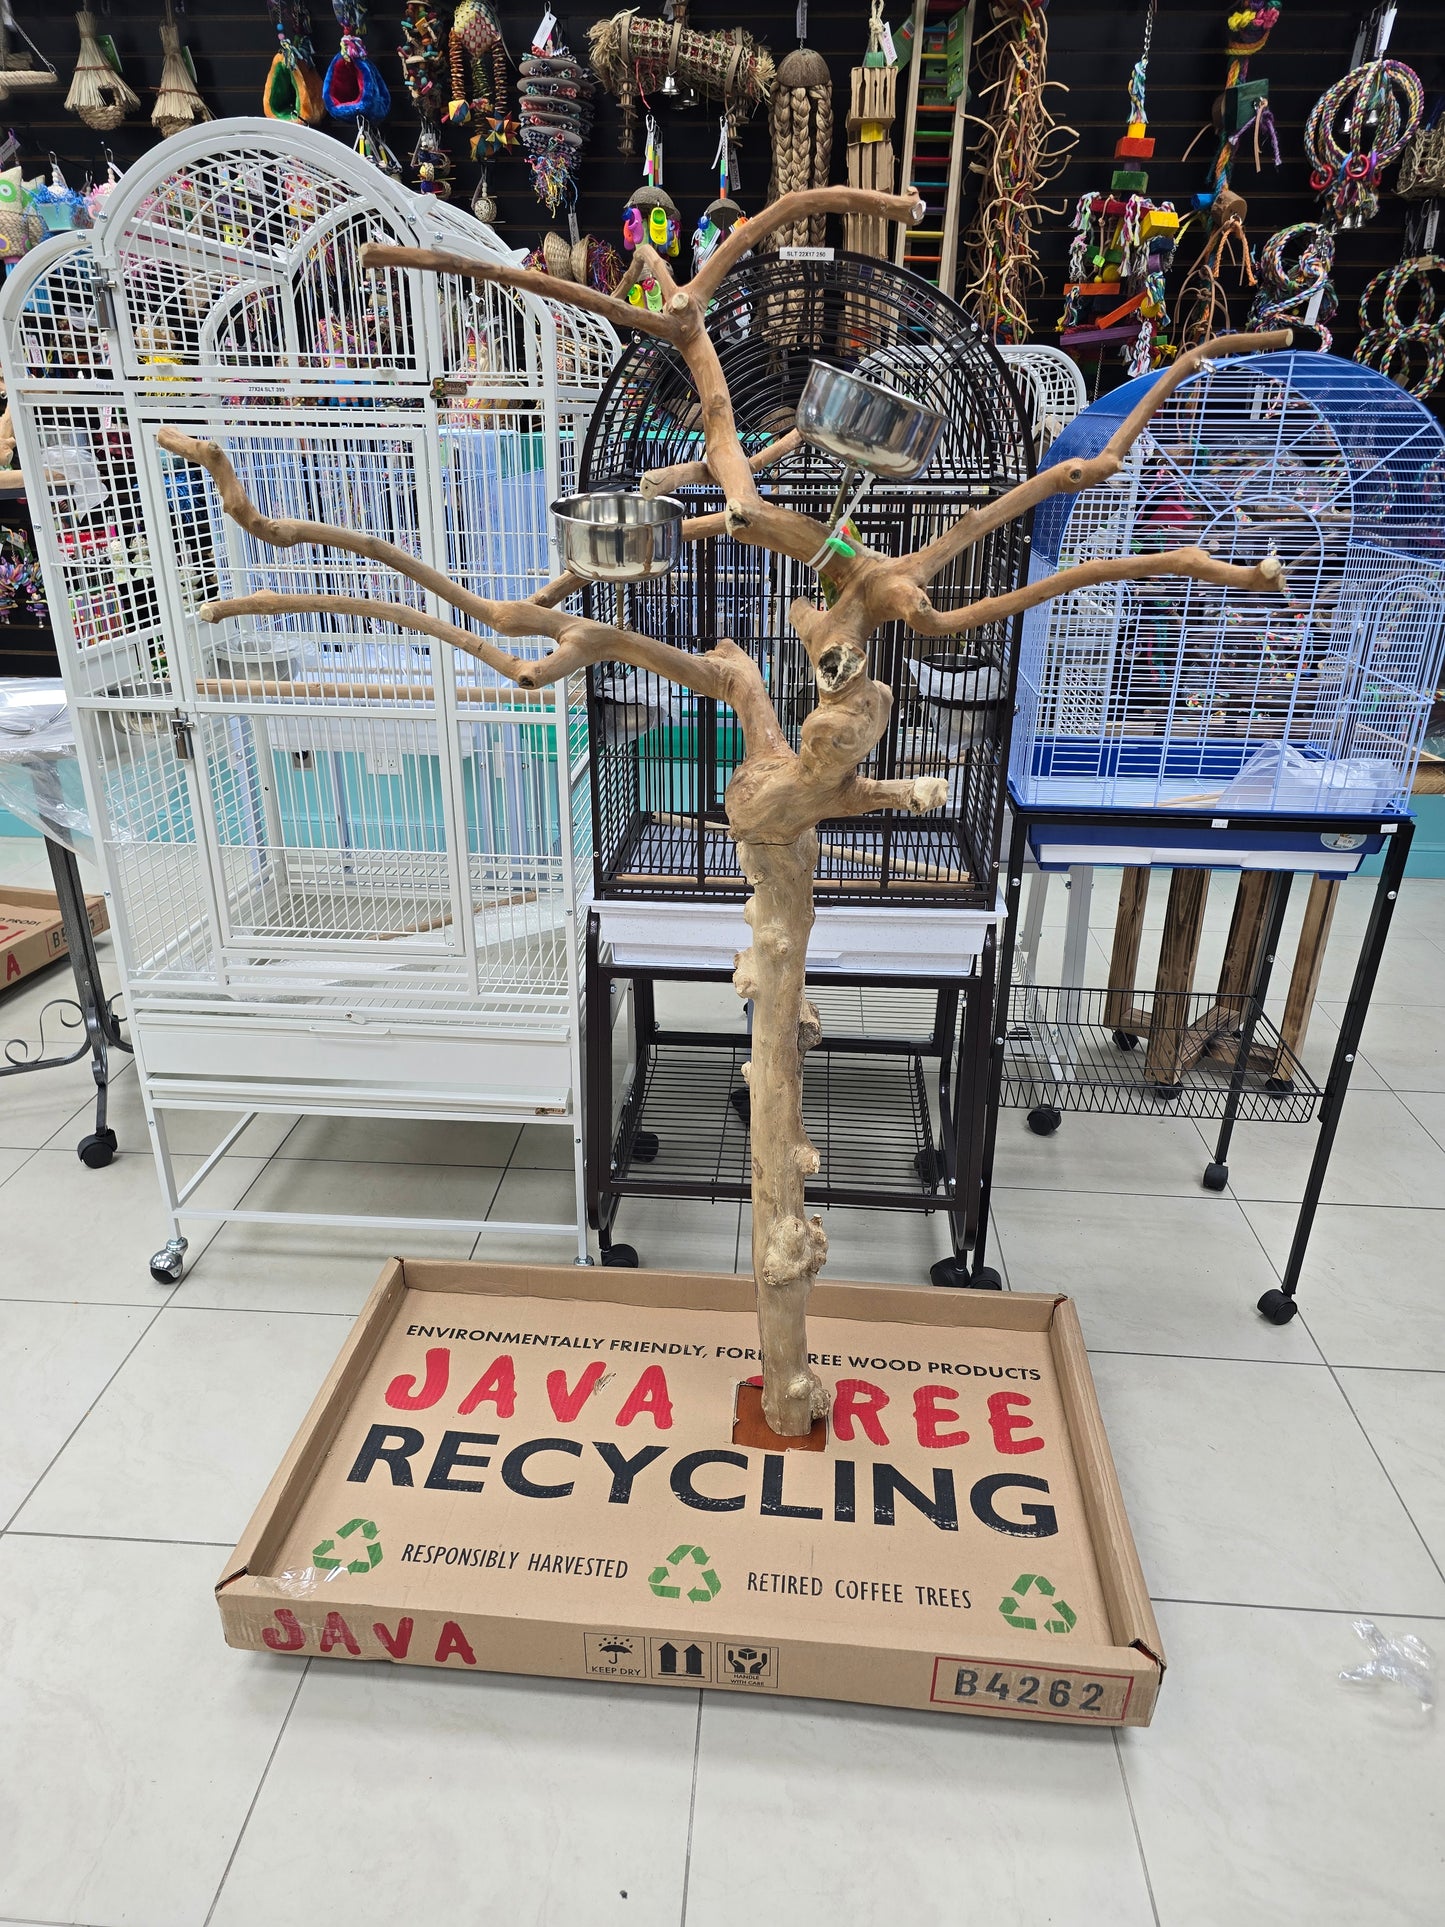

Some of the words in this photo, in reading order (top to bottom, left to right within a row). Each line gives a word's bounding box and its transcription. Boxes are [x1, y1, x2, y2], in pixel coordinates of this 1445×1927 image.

[406, 1325, 604, 1350] ENVIRONMENTALLY
[609, 1339, 708, 1359] FRIENDLY,
[848, 1355, 921, 1372] WOOD
[928, 1362, 1042, 1381] PRODUCTS
[384, 1347, 674, 1430] JAVA
[746, 1375, 1045, 1455] REE
[346, 1423, 1059, 1538] RECYCLING
[401, 1543, 520, 1570] RESPONSIBLY
[527, 1553, 628, 1579] HARVESTED
[747, 1571, 823, 1597] RETIRED
[835, 1579, 904, 1604] COFFEE
[915, 1586, 972, 1609] TREES
[262, 1608, 477, 1665] JAVA
[591, 1665, 617, 1674] KEEP
[620, 1667, 641, 1676] DRY
[954, 1668, 1105, 1711] B4262
